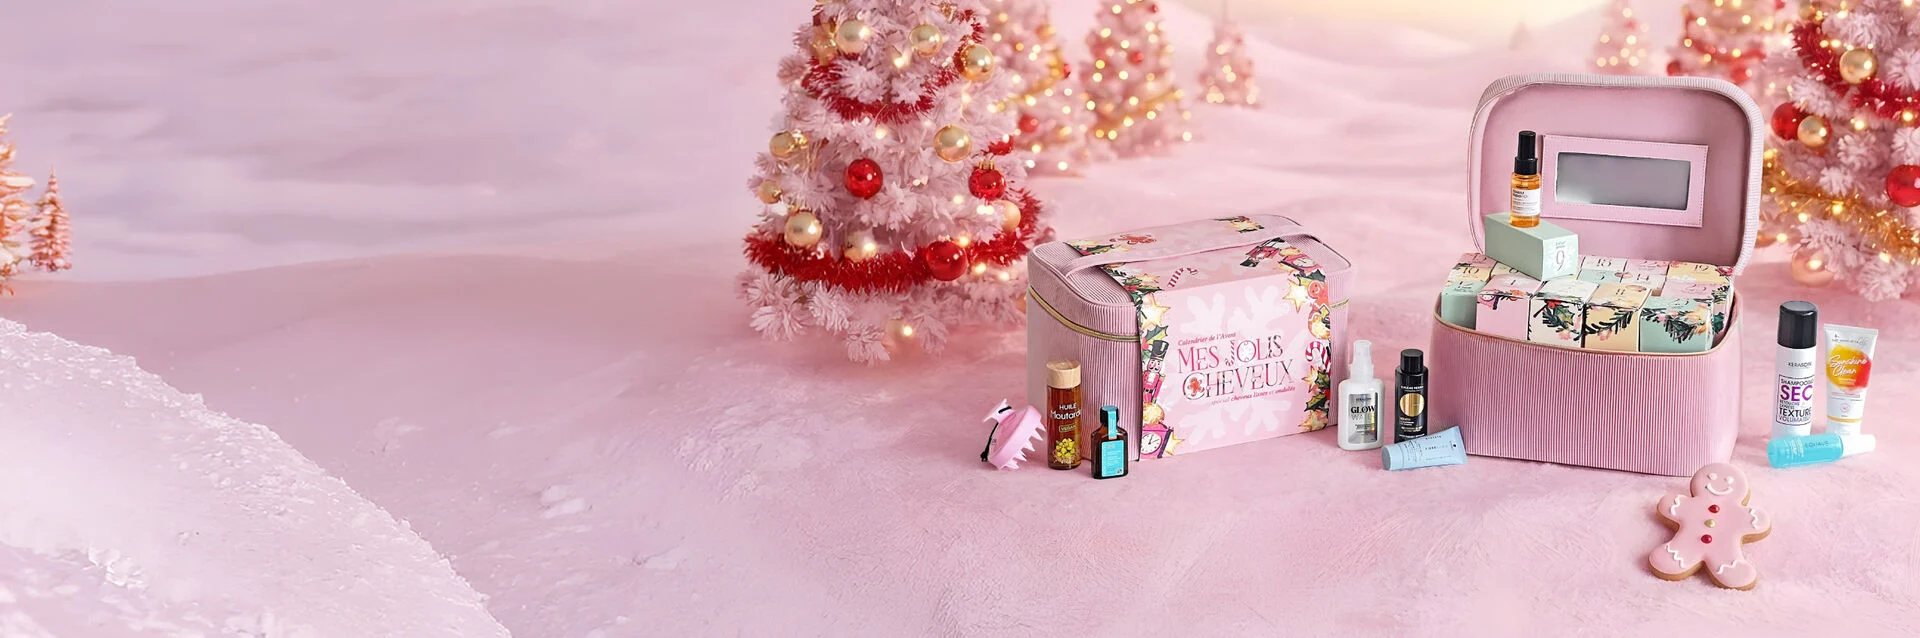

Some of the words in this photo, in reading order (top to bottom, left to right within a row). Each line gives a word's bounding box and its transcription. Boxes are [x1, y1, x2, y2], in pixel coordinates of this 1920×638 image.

[1556, 249, 1565, 271] 9
[1177, 345, 1220, 374] MES
[1225, 335, 1283, 367] JOLIS
[1830, 354, 1868, 368] Sunshine
[1832, 365, 1857, 377] Clean
[1182, 359, 1294, 401] CHEVEUX
[1230, 394, 1252, 402] cheveux
[1780, 384, 1813, 401] SEC
[1059, 402, 1077, 410] HUILE
[1350, 405, 1375, 414] GLOW
[1779, 406, 1812, 417] TEXTURE
[1050, 408, 1081, 420] Moutard
